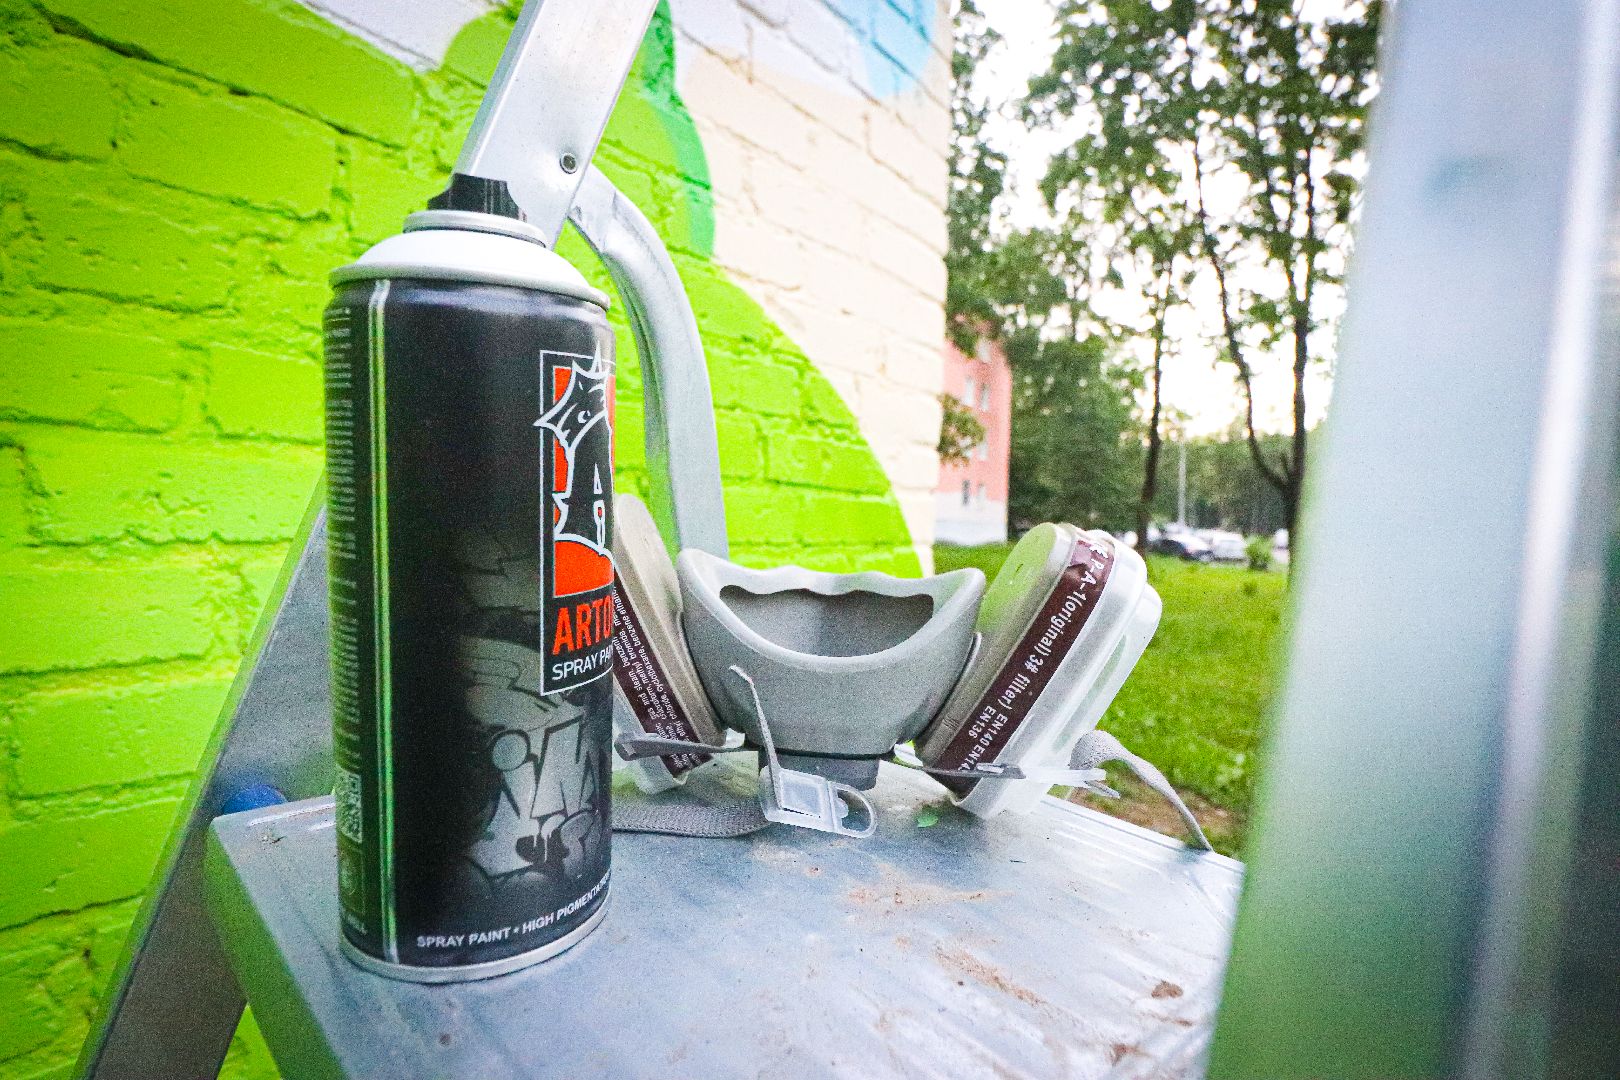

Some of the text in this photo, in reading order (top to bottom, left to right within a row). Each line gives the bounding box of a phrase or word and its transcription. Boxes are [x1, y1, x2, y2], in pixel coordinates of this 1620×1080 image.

[552, 594, 613, 656] ARTO
[552, 653, 598, 680] SPRAY
[967, 704, 996, 739] EN136
[958, 712, 1008, 776] EN140 EN14
[417, 935, 465, 948] SPRAY
[469, 926, 512, 945] PAINT
[522, 912, 555, 934] HIGH
